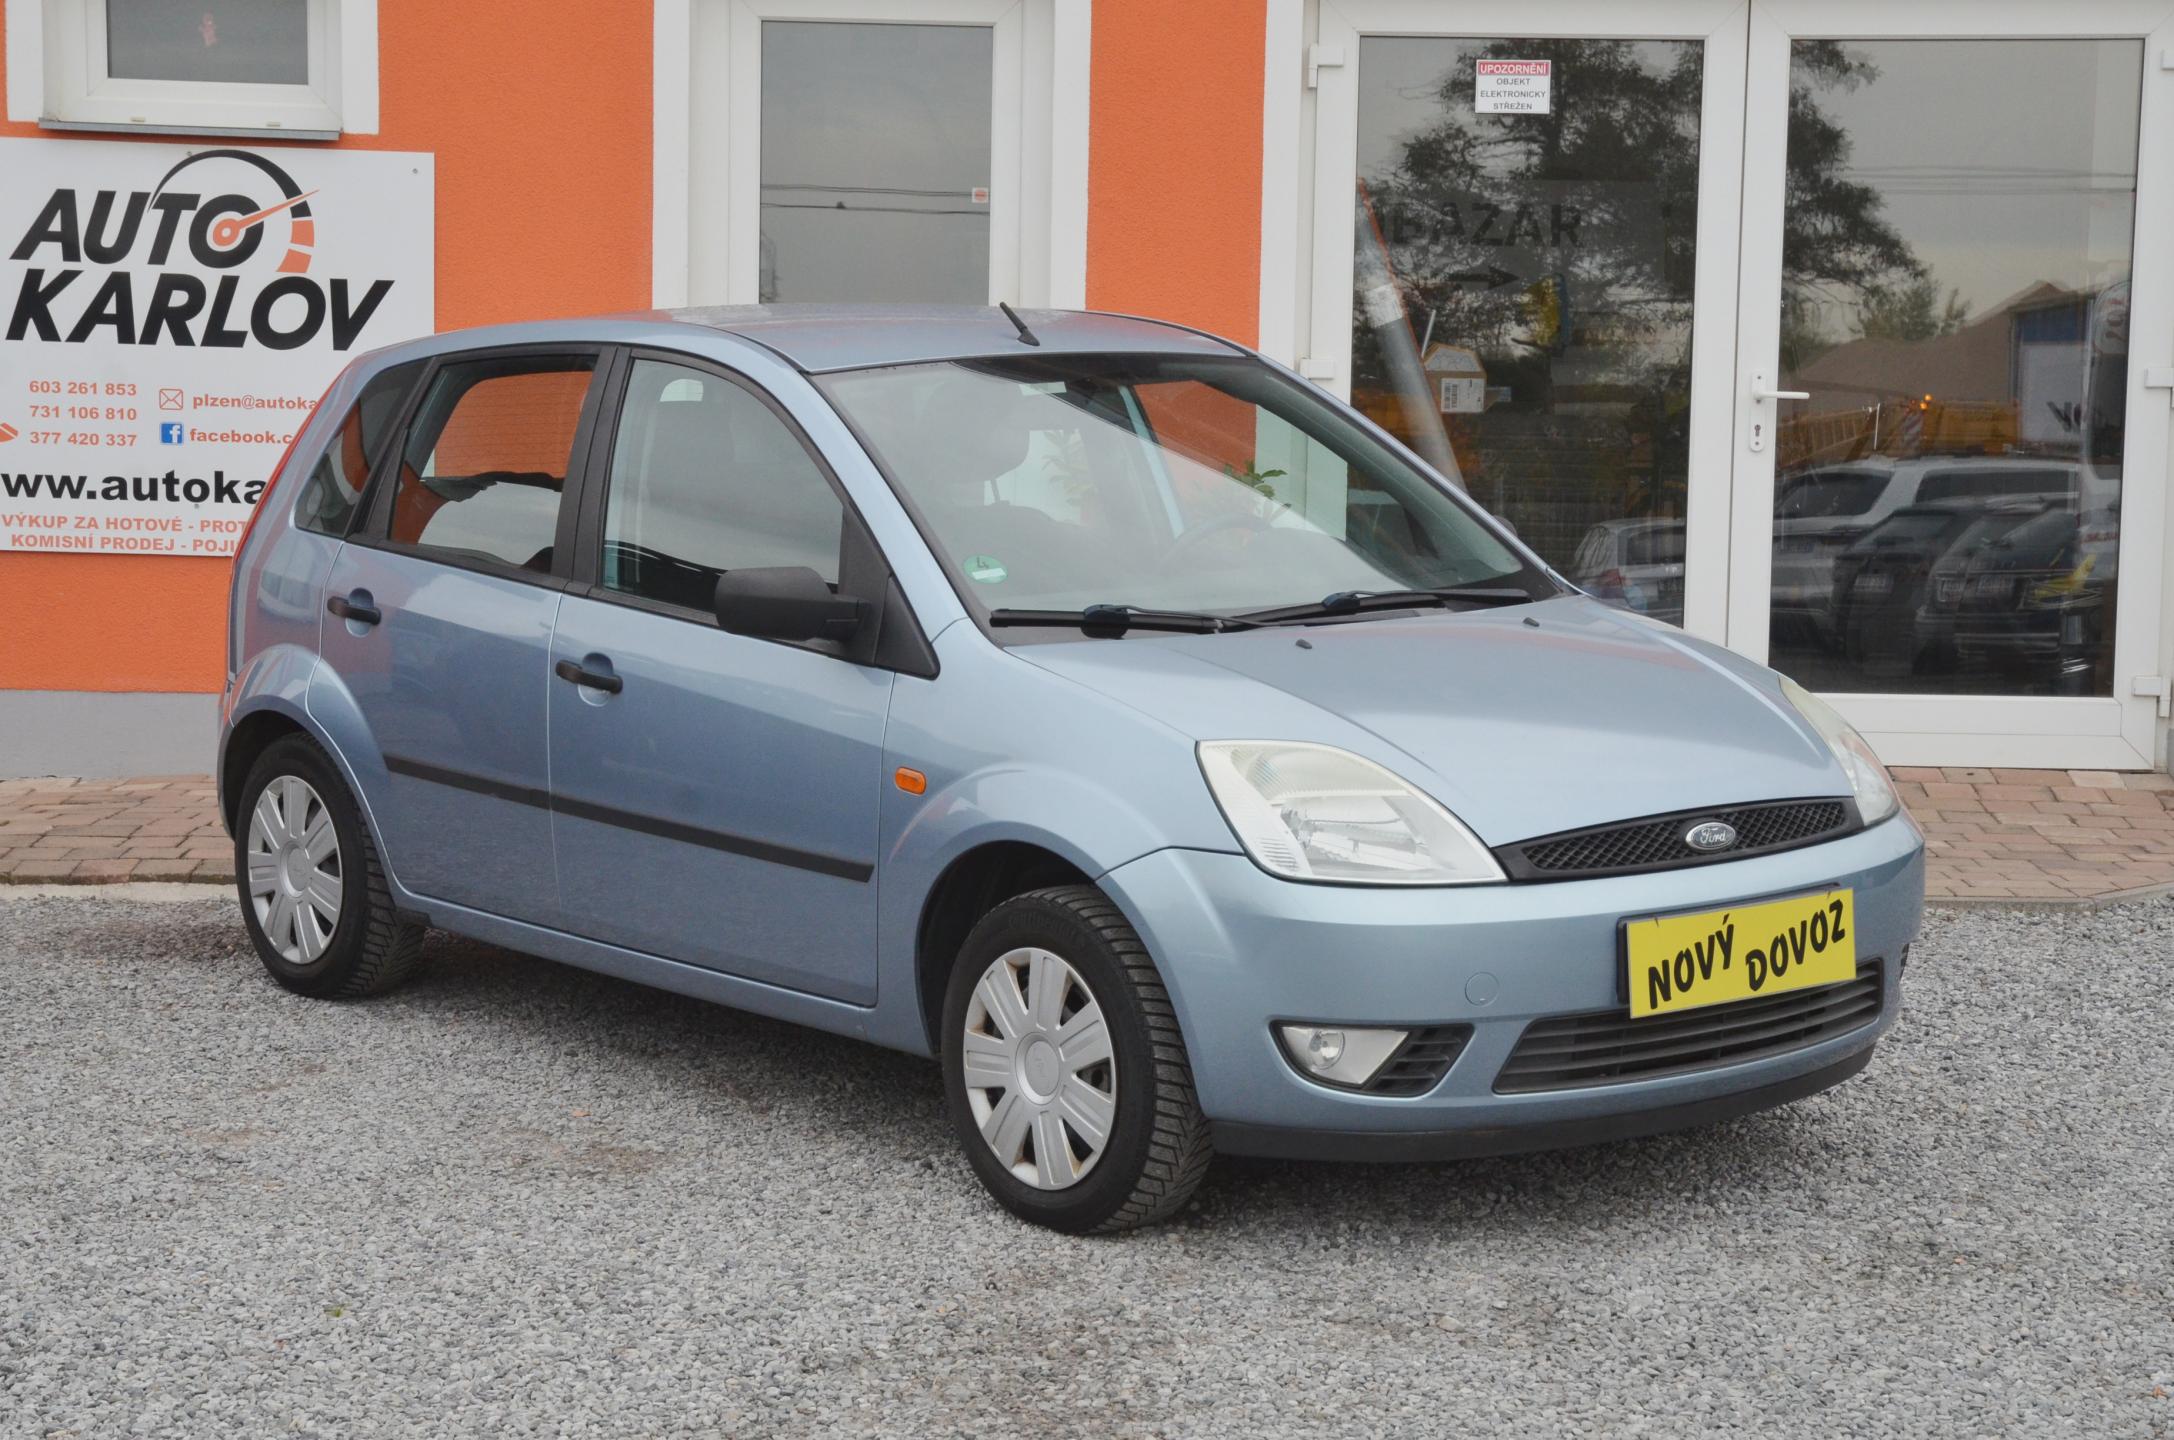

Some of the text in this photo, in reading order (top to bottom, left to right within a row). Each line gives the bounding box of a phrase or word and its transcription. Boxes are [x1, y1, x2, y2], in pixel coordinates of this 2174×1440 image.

[1480, 62, 1547, 74] UPOZORNĚNÍ
[1480, 90, 1546, 98] ELEKTRONICKY
[10, 188, 264, 269] AUTO
[6, 268, 395, 351] KARLOV
[29, 380, 137, 396] 603 261 853
[29, 405, 137, 421] 731 106 810
[30, 431, 137, 447] 377 420 337
[2, 512, 68, 528] VÝKUP
[74, 516, 99, 529] ZA
[105, 515, 182, 532] HOTOVÉ
[11, 532, 94, 548] KOMISNÍ
[101, 536, 175, 551] PRODEJ
[193, 539, 239, 553] POJI
[1700, 827, 1726, 844] Ford
[1648, 899, 1845, 1010] NOVÝ DOVOZ
